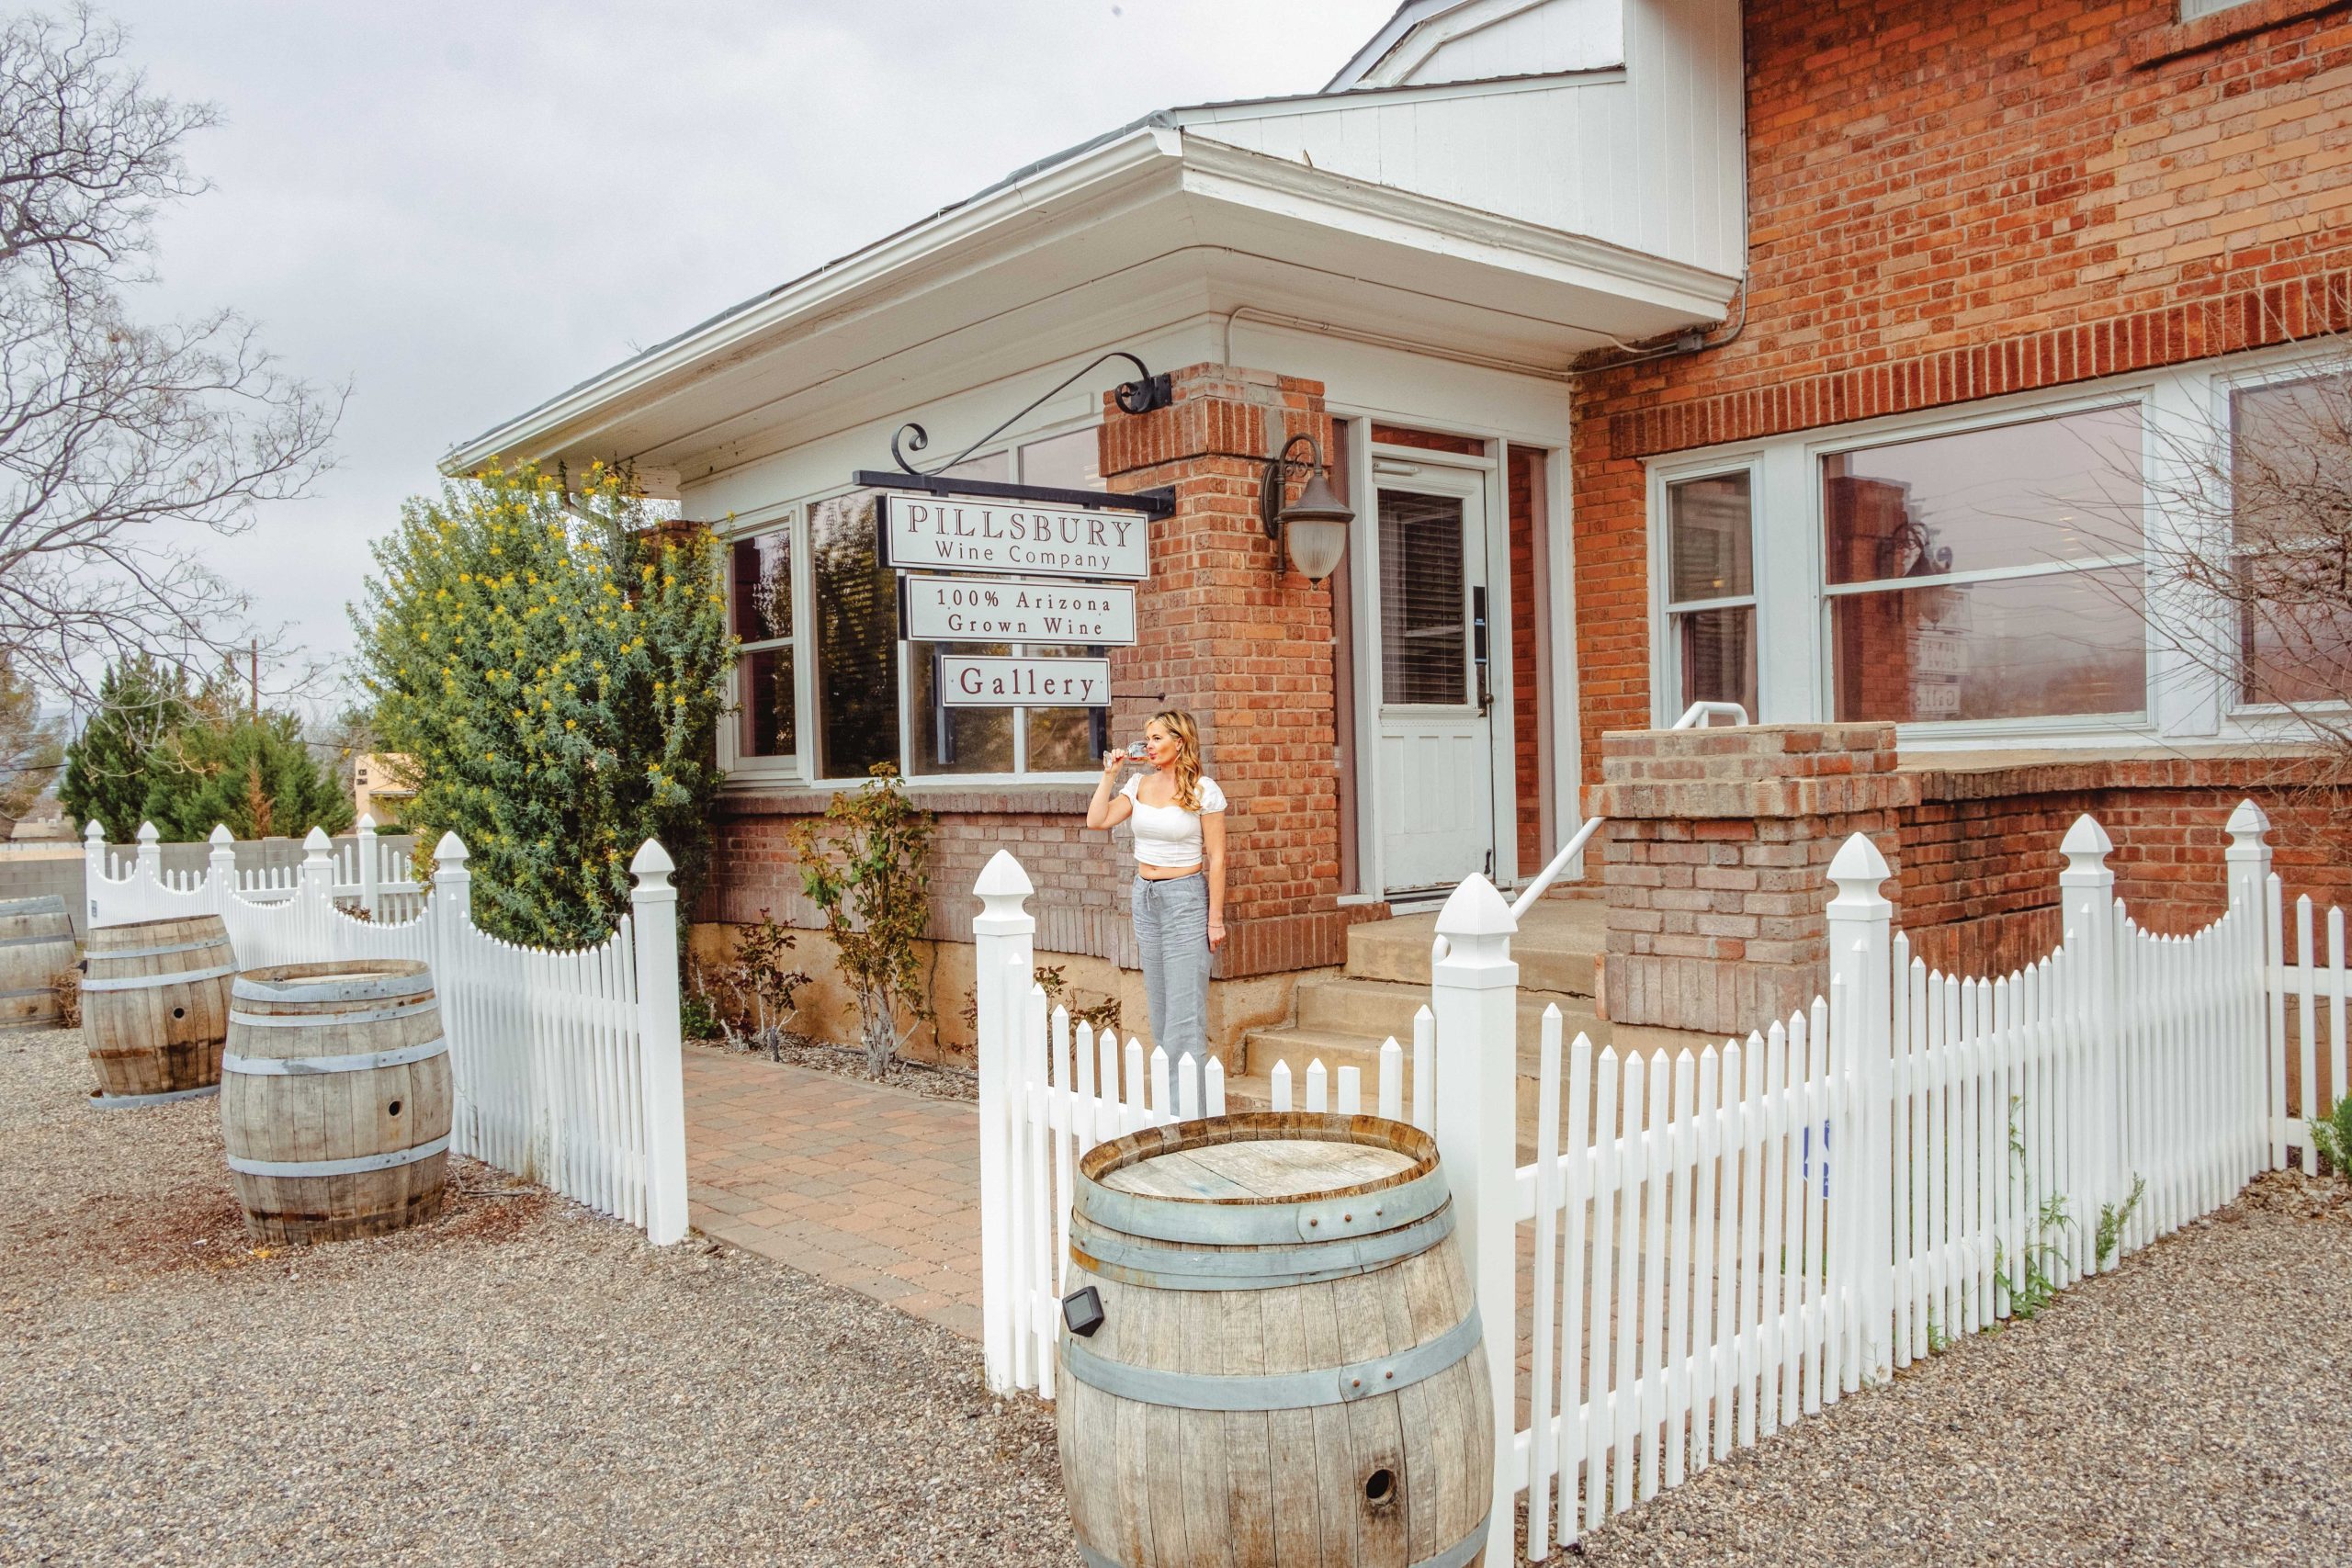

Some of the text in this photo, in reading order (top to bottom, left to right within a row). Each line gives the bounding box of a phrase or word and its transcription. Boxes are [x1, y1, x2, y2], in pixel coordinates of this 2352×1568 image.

[907, 504, 1132, 547] PILLSBURY
[934, 540, 1110, 570] Wine Company
[937, 588, 1111, 612] 100% Arizona
[948, 614, 1102, 635] Grown Wine
[960, 667, 1094, 702] Gallery
